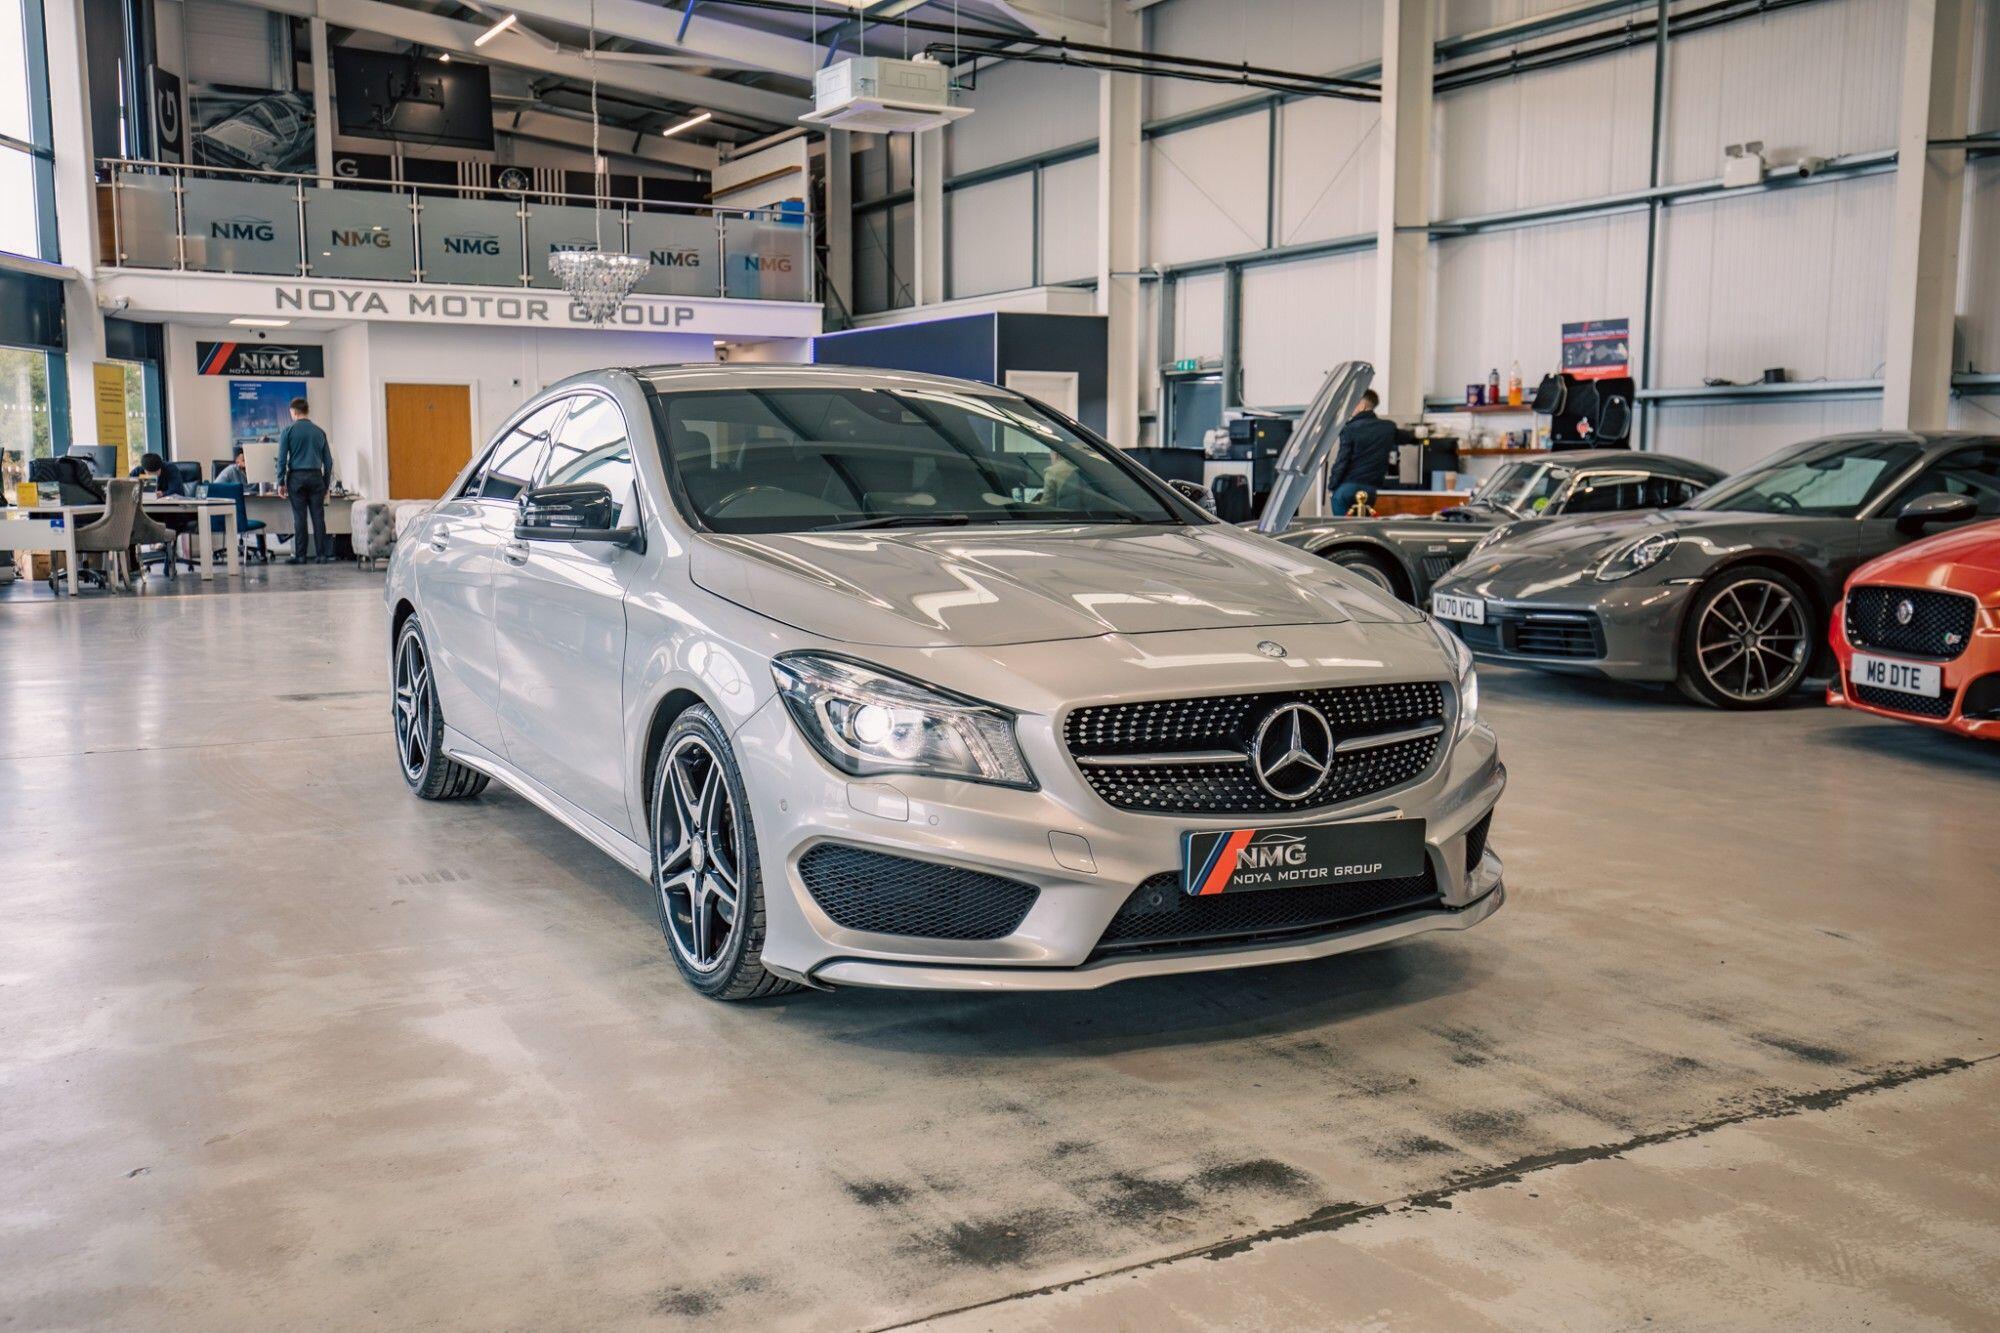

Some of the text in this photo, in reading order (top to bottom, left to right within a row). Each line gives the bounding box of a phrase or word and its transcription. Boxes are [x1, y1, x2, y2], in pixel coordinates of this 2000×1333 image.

[211, 222, 275, 241] NMG
[332, 230, 391, 248] NMG
[444, 237, 500, 255] NMG
[650, 251, 700, 267] NMG
[745, 256, 792, 273] NMG
[275, 287, 695, 326] NOYA MOTOR GOUP
[240, 353, 300, 370] NMG
[1460, 599, 1478, 619] VCL
[1867, 660, 1921, 689] M8 DTE
[1235, 844, 1307, 869] NMG
[1233, 863, 1383, 885] NOYA MOTOR GROUP
